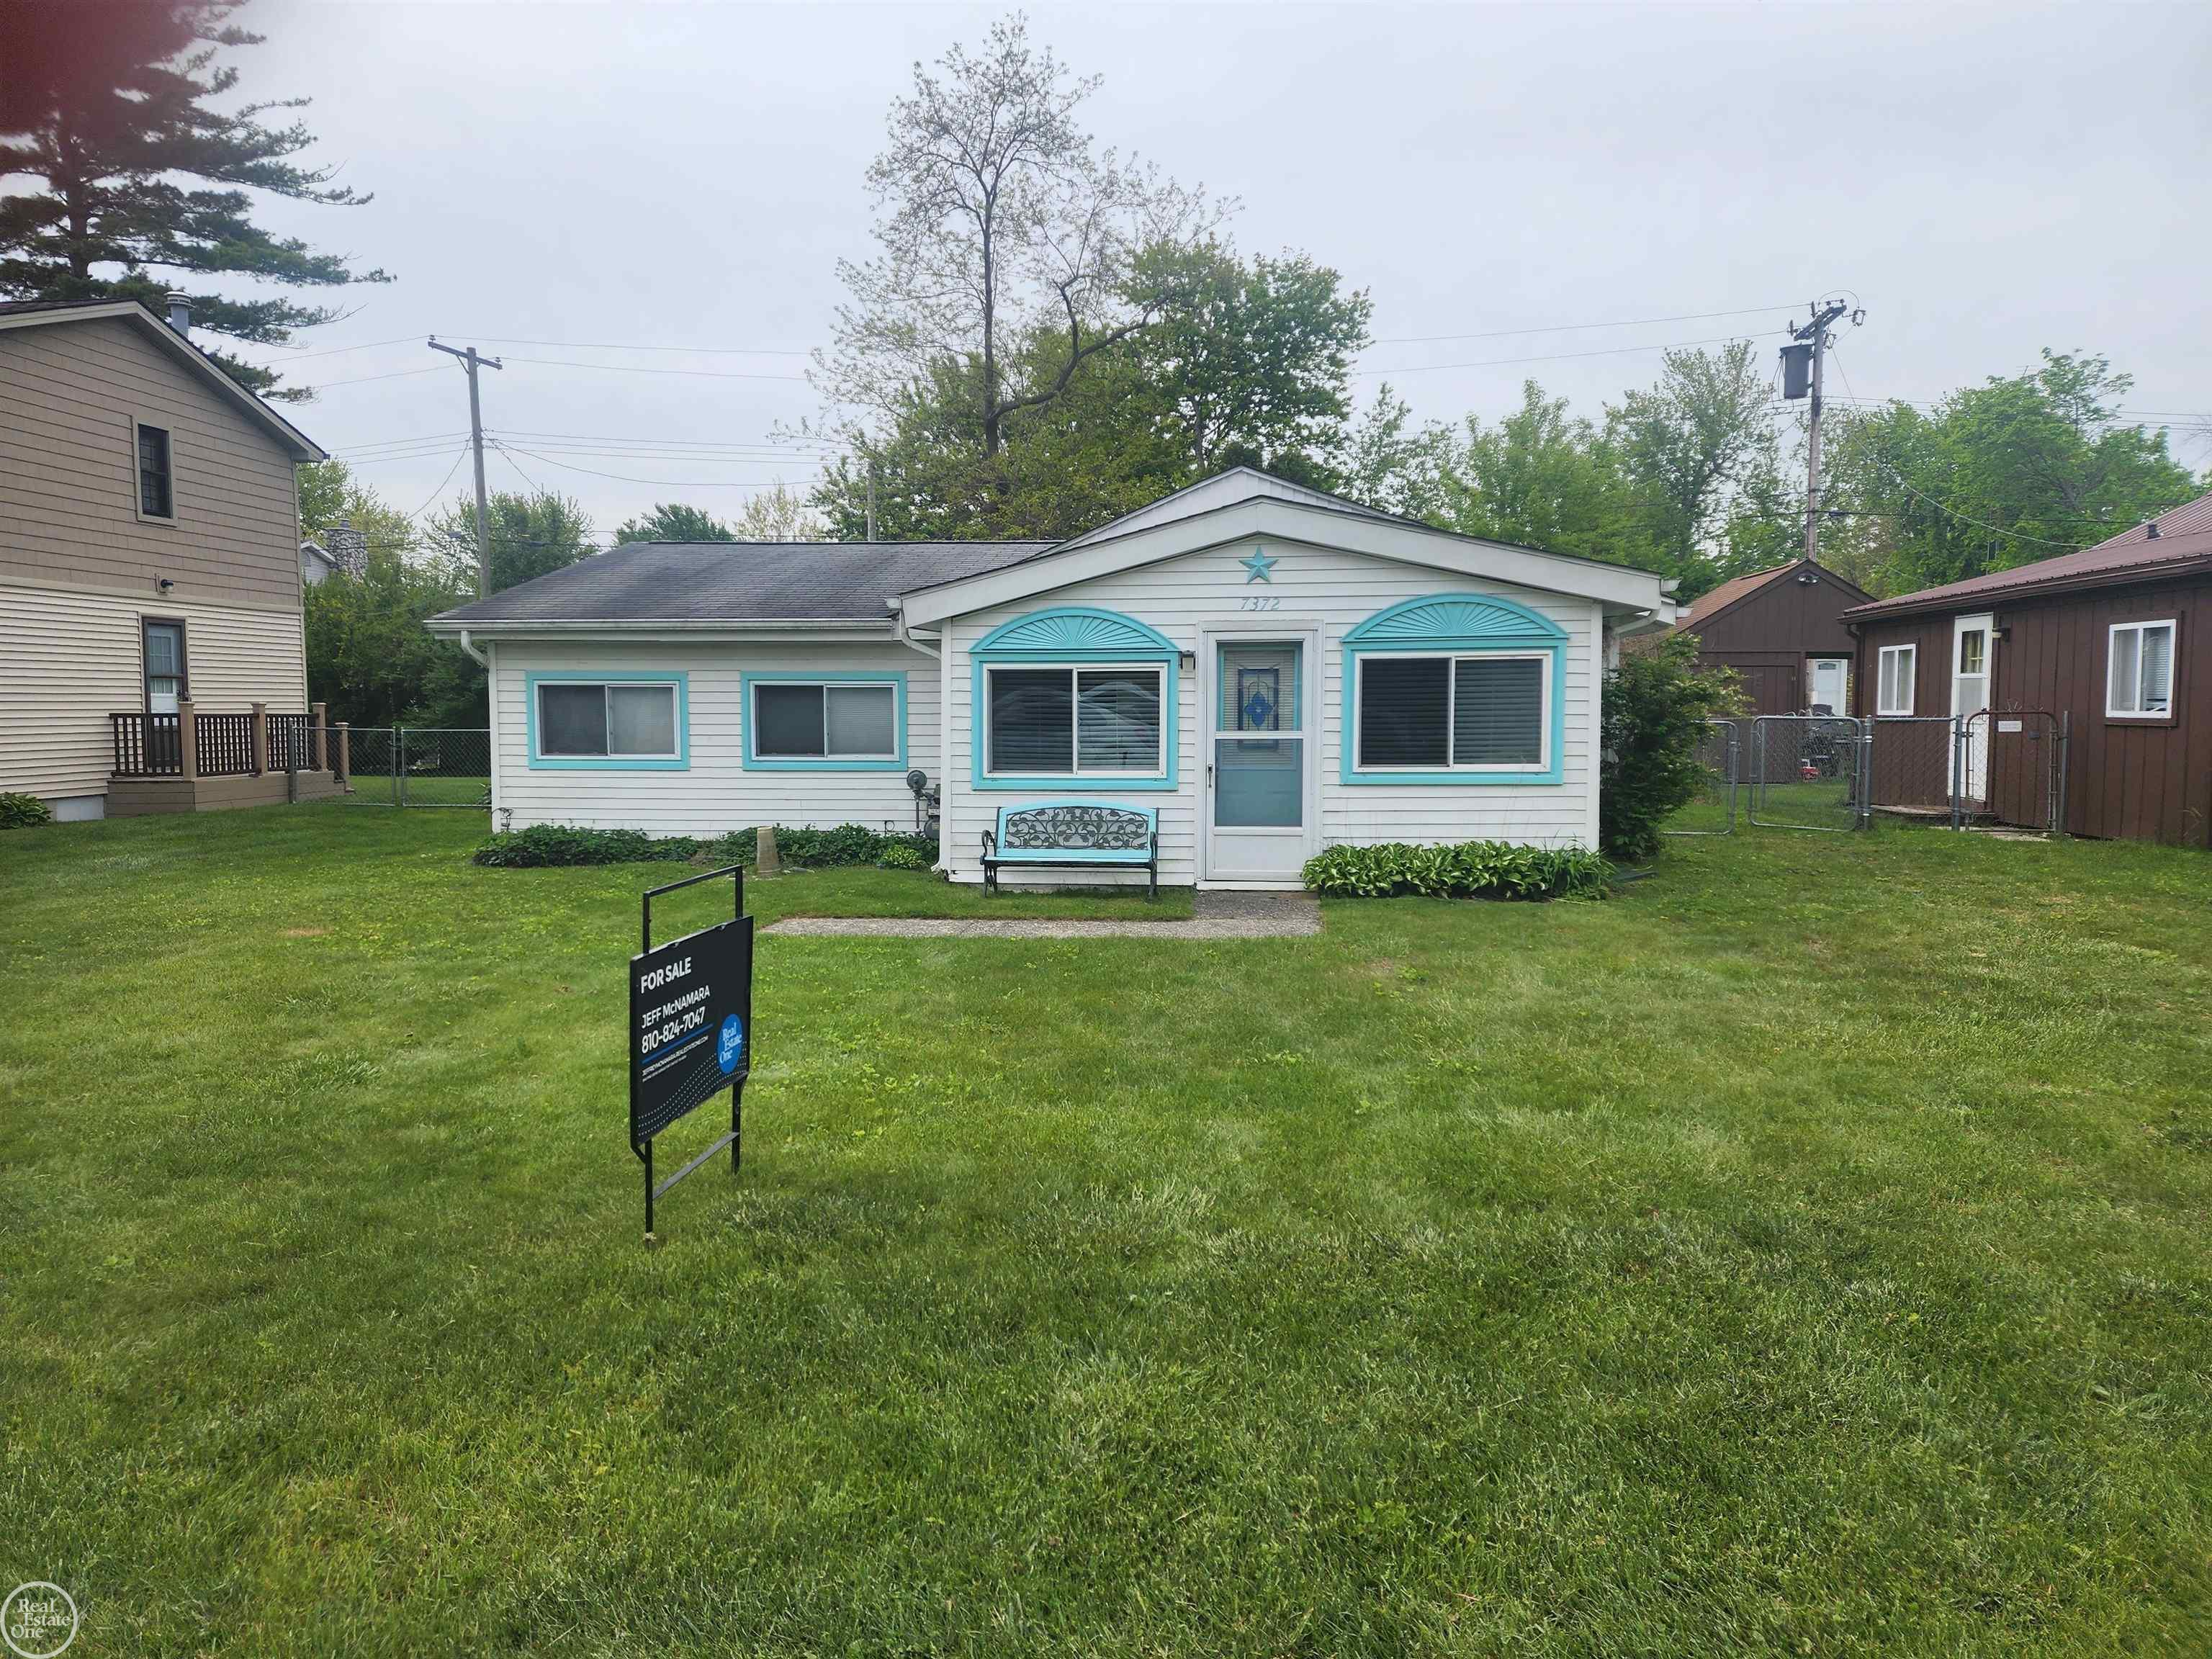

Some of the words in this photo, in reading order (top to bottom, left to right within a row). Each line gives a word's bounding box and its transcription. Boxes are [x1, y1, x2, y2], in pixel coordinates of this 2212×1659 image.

[1241, 597, 1280, 611] 7372
[641, 968, 664, 994] FOR
[665, 956, 691, 982] SALE
[642, 1007, 662, 1029] JEFF
[662, 984, 710, 1018] McNAMARA
[642, 1006, 706, 1053] 810-824-7047
[722, 1022, 737, 1040] Real
[724, 1034, 742, 1052] Estate
[719, 1050, 733, 1064] One
